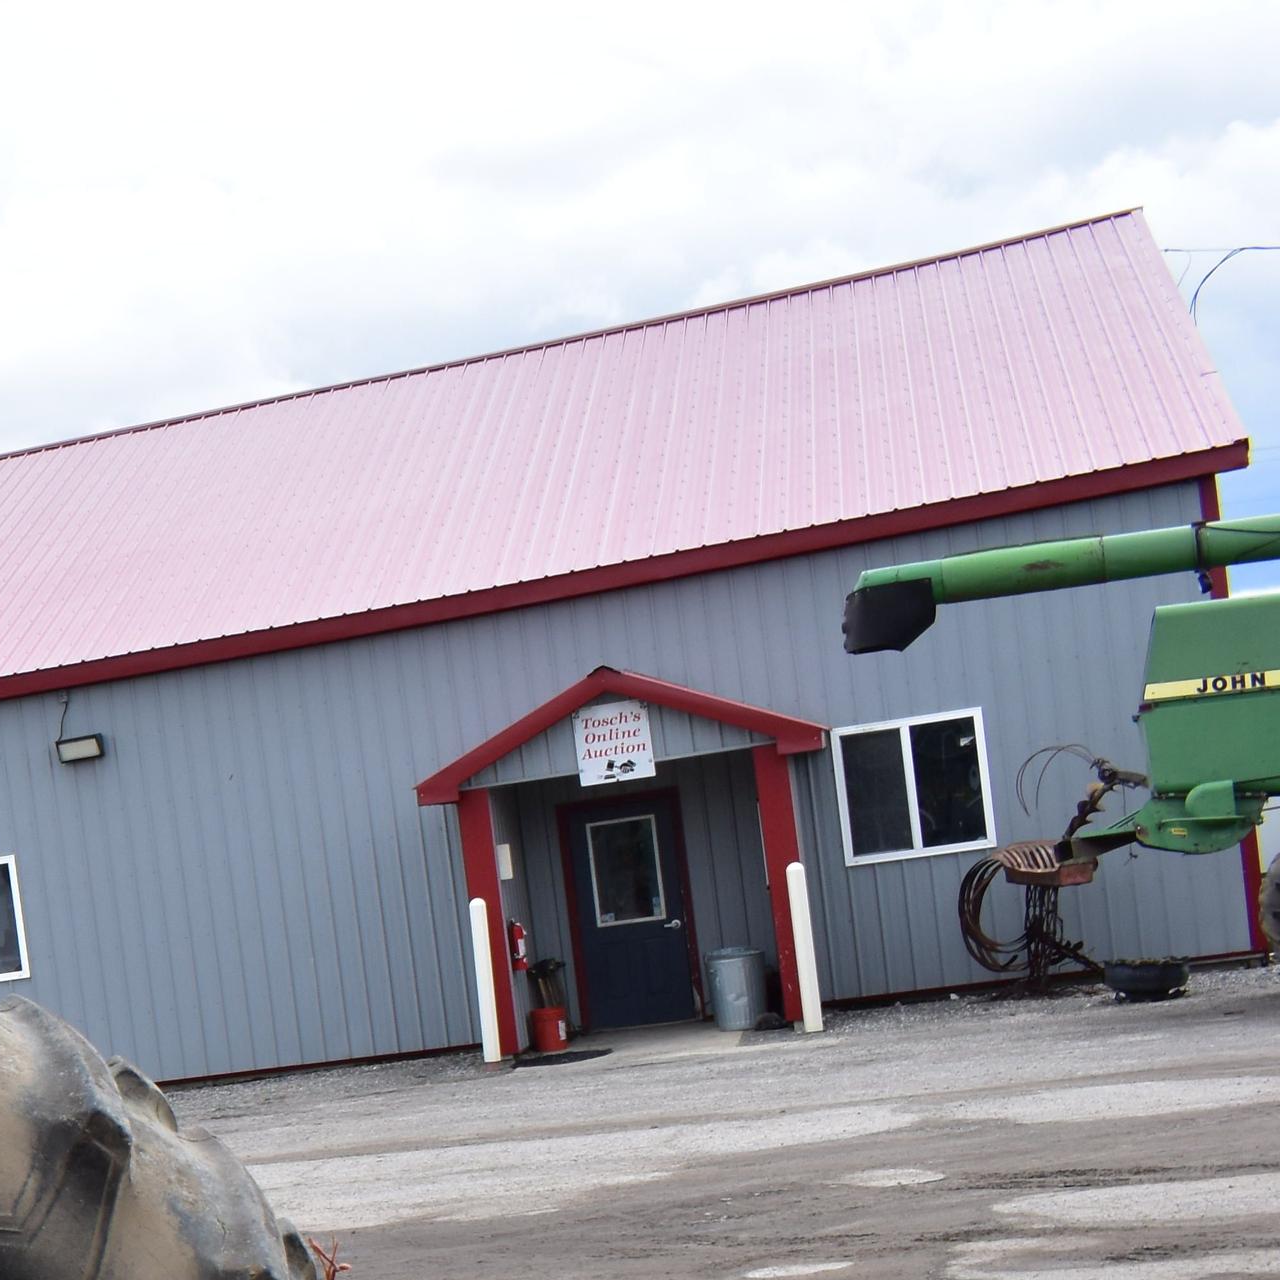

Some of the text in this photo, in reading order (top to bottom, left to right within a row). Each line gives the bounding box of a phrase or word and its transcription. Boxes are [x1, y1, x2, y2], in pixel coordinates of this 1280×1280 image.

[1197, 672, 1266, 693] JOHN
[582, 711, 642, 730] Tosch's
[585, 728, 641, 744] Online
[582, 742, 647, 760] Auction
